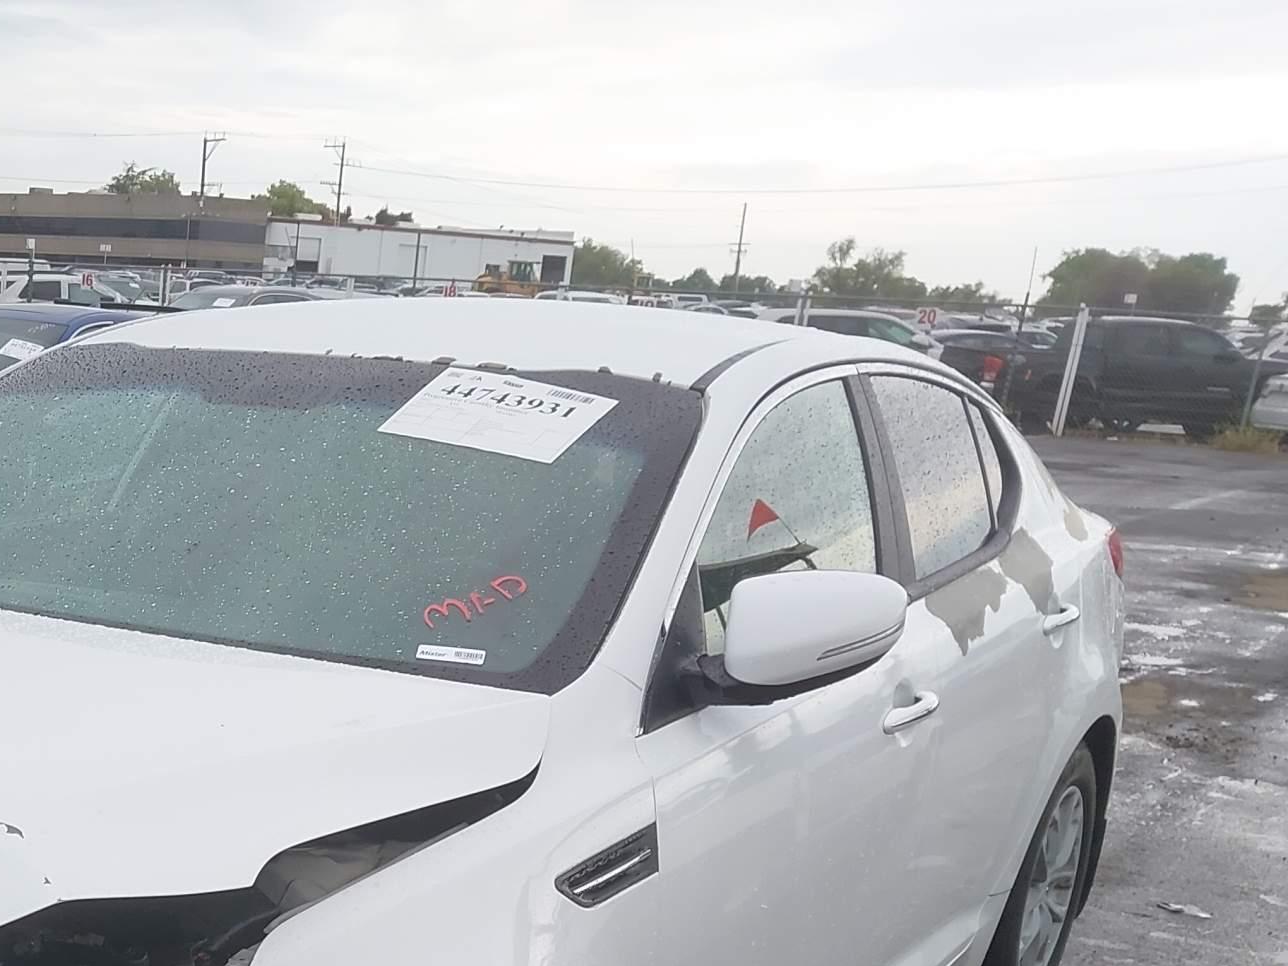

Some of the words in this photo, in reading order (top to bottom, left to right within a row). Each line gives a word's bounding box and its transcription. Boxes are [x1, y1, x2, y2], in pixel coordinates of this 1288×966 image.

[82, 273, 93, 286] 16
[918, 309, 937, 324] 20
[441, 383, 577, 418] 44743931
